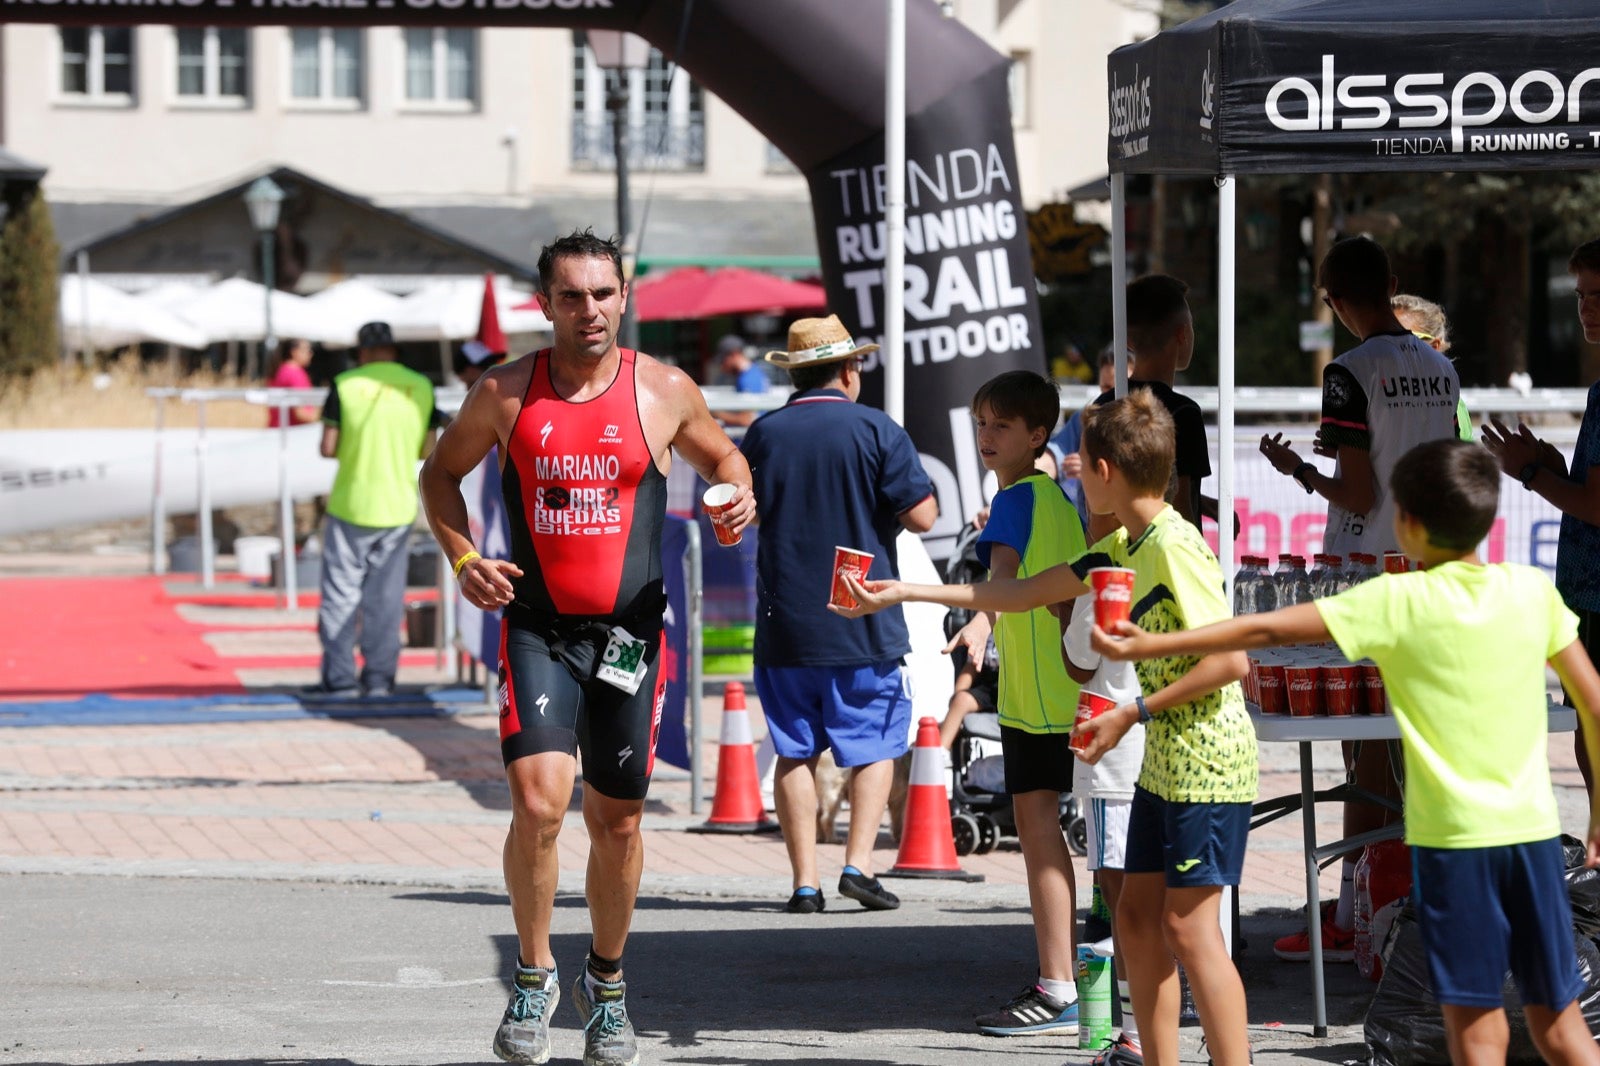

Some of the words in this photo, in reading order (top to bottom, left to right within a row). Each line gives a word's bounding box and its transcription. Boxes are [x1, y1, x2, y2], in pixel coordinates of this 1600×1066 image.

[1371, 136, 1447, 155] TIENDA
[1470, 132, 1569, 152] RUNNING
[535, 454, 620, 480] MARIANO
[535, 508, 621, 525] RUEDAS
[535, 523, 621, 535] Bikes
